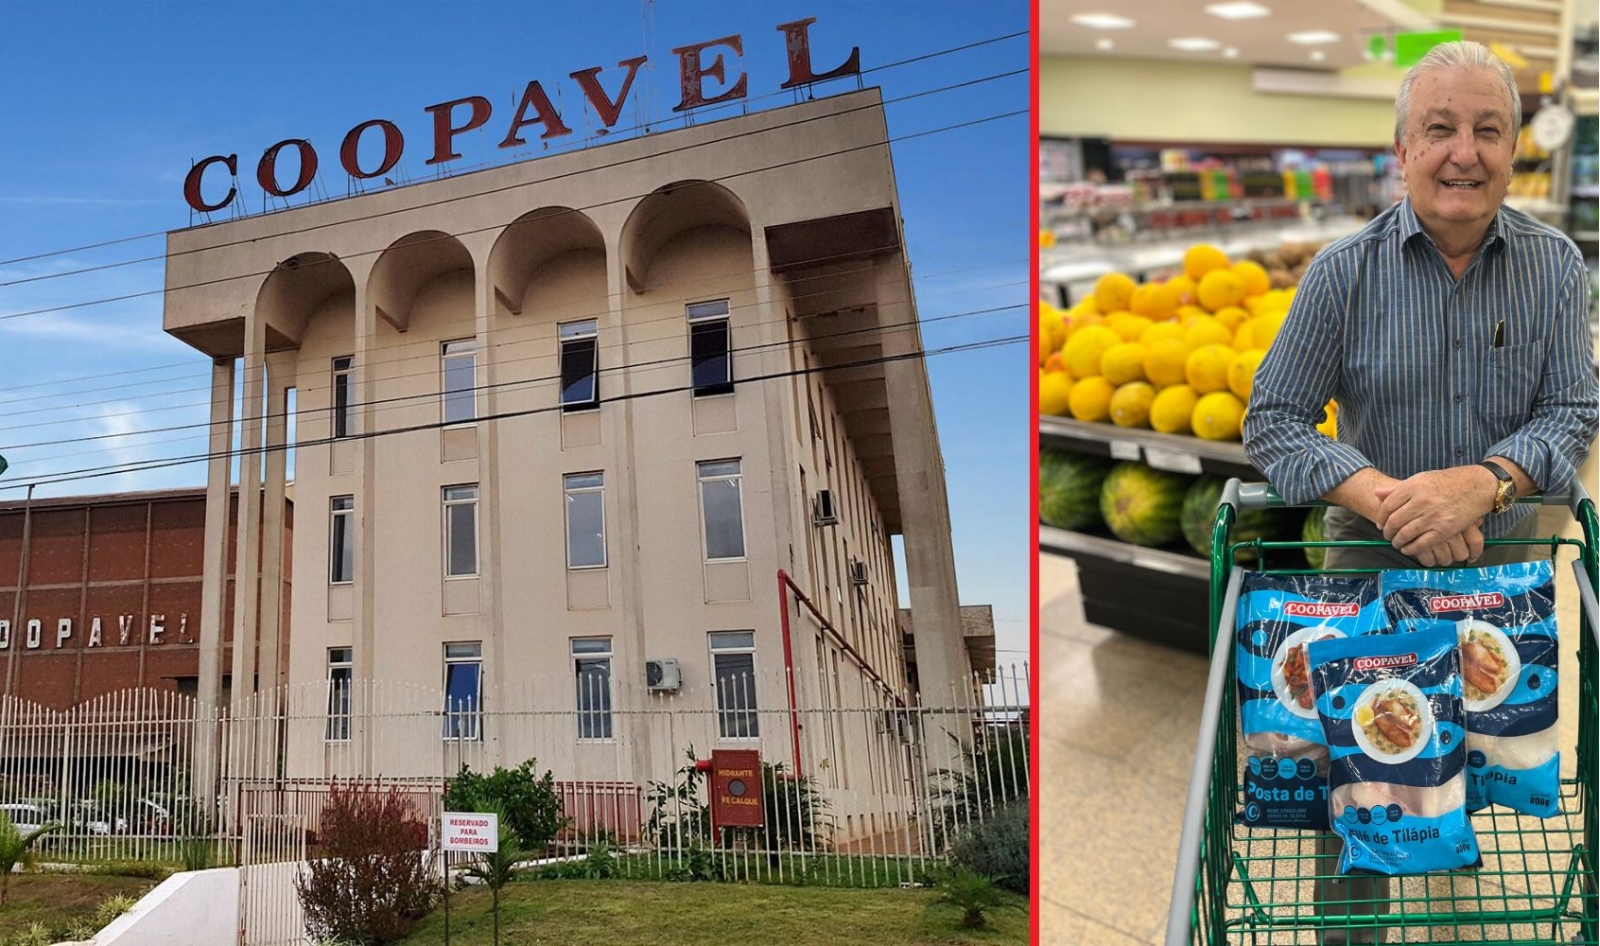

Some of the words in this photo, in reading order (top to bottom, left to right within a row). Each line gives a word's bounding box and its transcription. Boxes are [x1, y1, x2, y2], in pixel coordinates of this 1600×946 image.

[182, 17, 860, 212] COOPAVEL
[1287, 603, 1357, 617] COOPAVEL
[1431, 596, 1503, 611] COOPAVEL
[1356, 655, 1417, 670] COOPAVEL
[718, 769, 754, 777] HIDRANTE
[1248, 781, 1290, 802] Posta
[1294, 786, 1315, 801] de
[721, 796, 759, 806] RECALQUE
[450, 819, 489, 827] RESERVADO
[460, 828, 478, 836] PARA
[1373, 832, 1389, 845] de
[1392, 826, 1440, 843] Tilápia
[450, 837, 489, 846] BOMBEIROS
